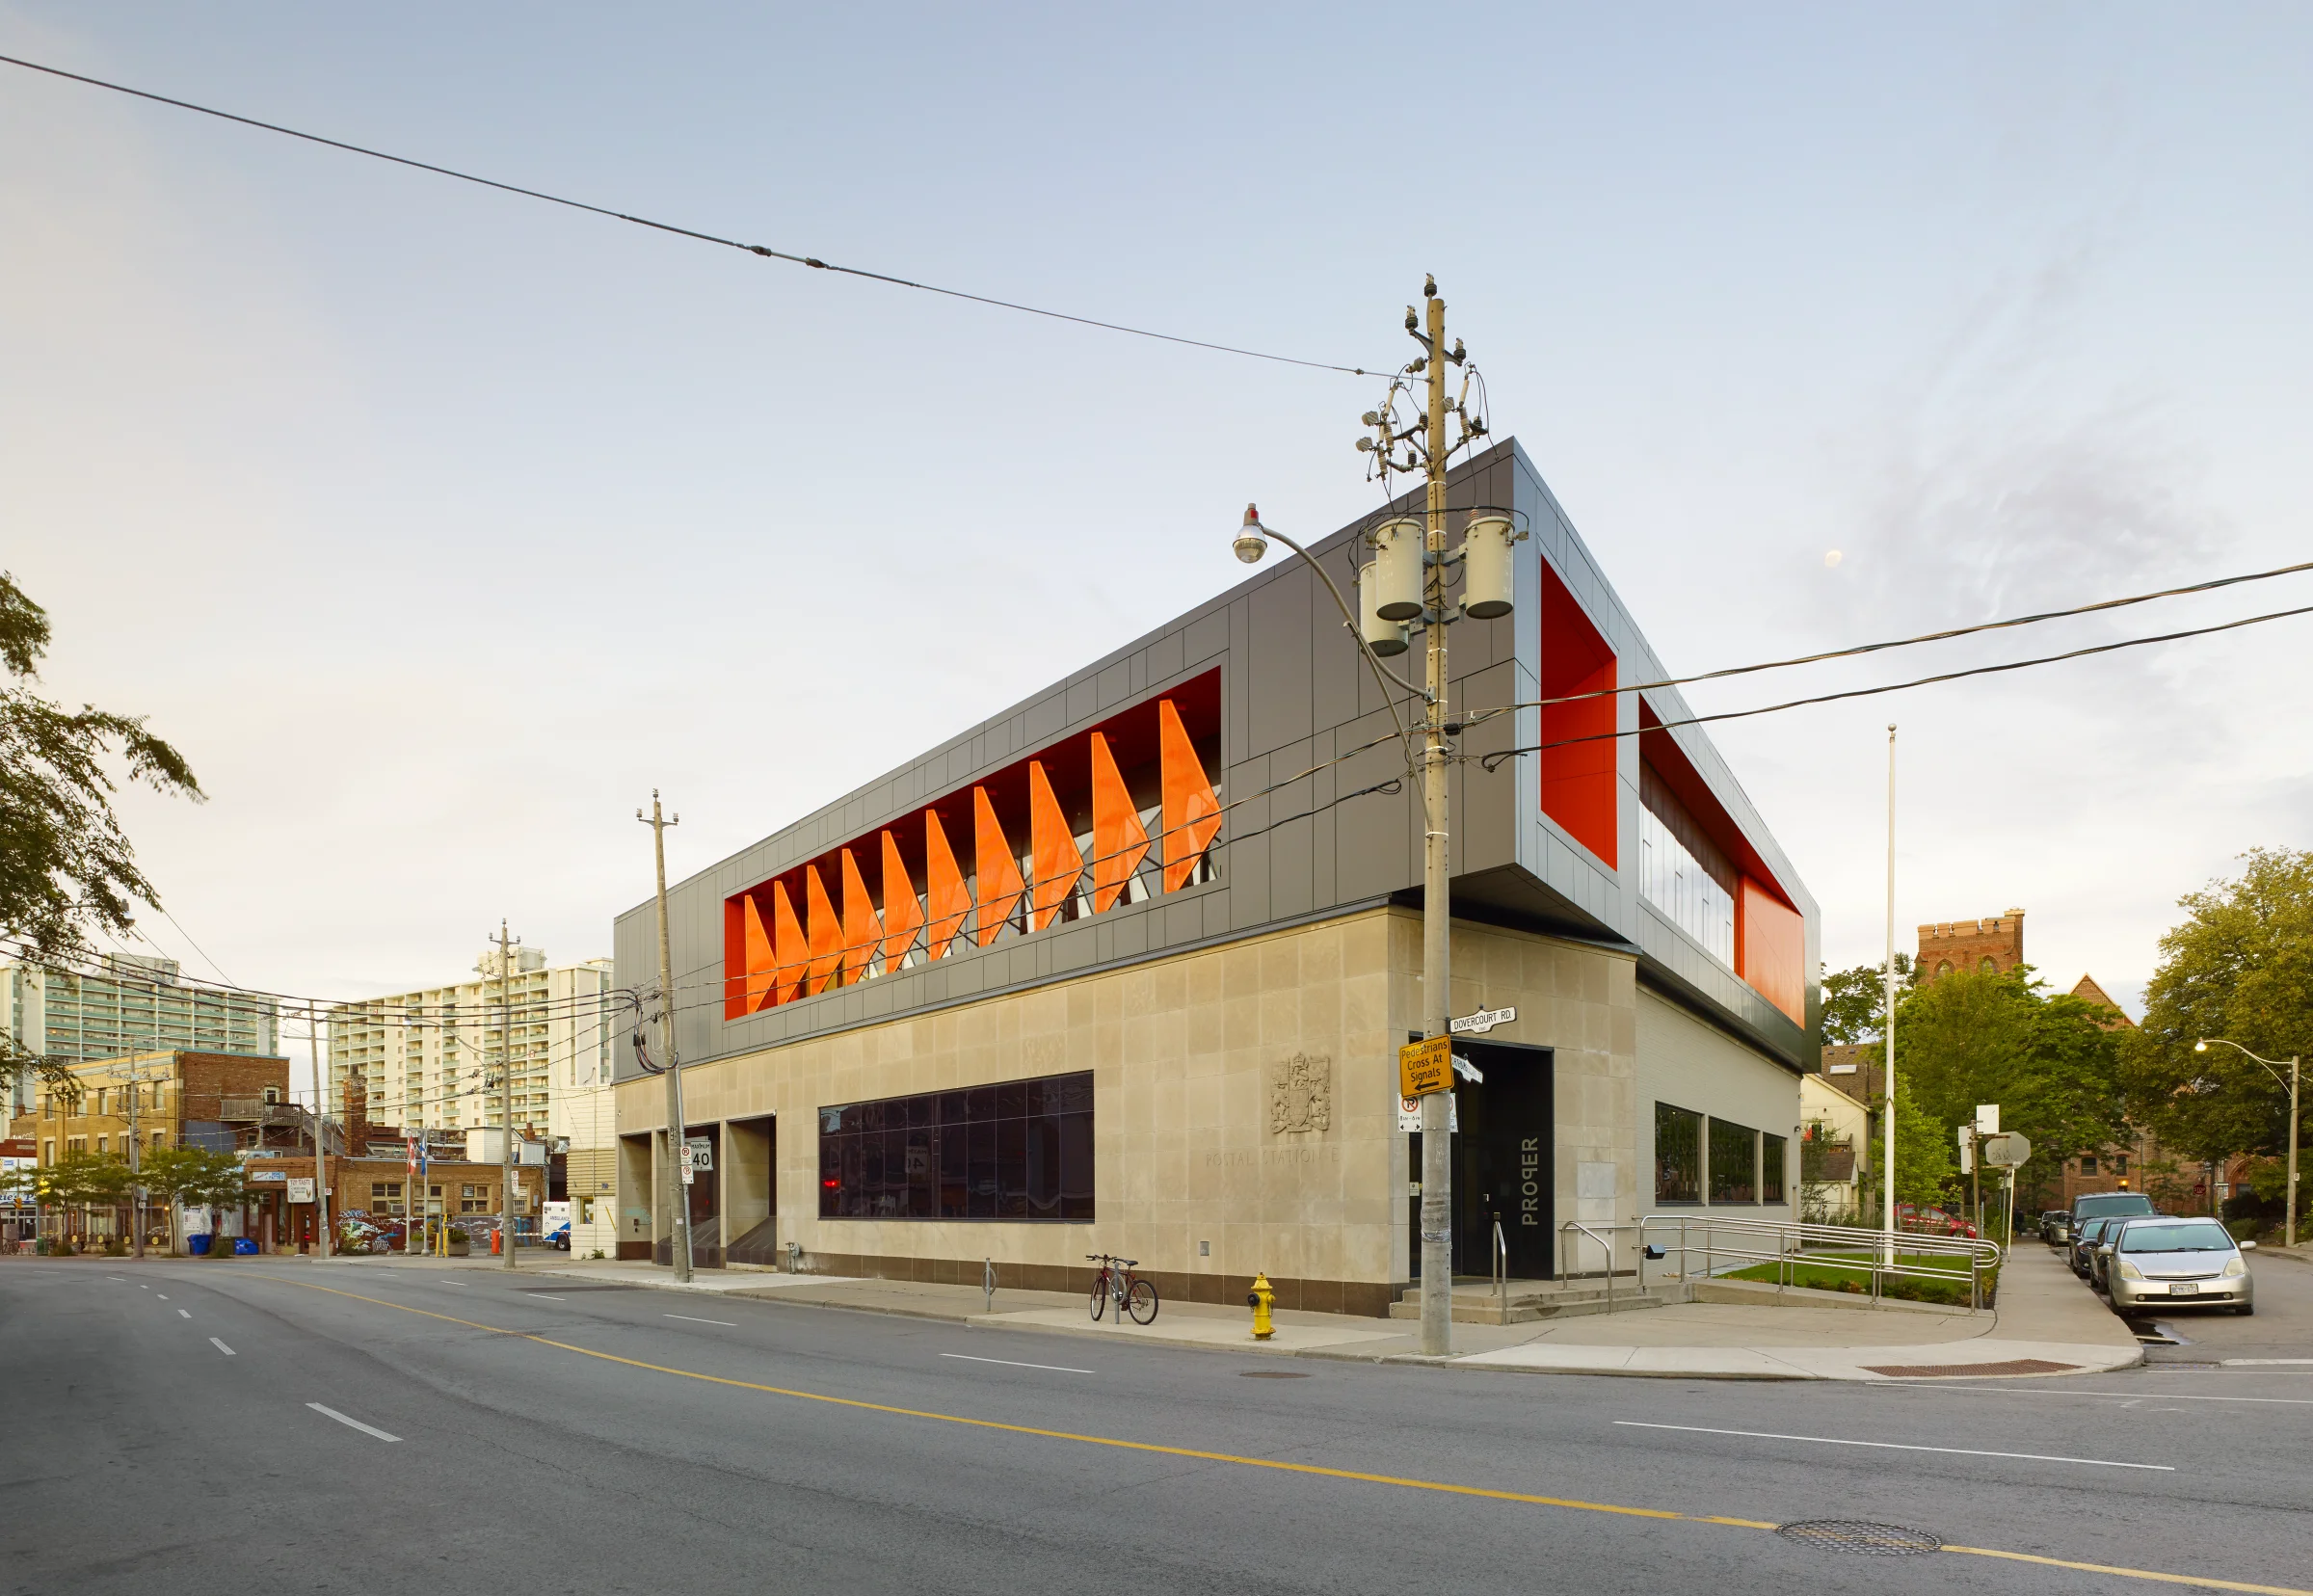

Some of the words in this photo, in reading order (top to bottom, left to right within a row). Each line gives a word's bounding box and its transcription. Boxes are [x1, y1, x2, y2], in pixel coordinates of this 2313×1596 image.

[1453, 1012, 1498, 1030] DOVERCOURT
[1501, 1009, 1512, 1021] RD.
[1401, 1041, 1448, 1060] Pedestrians
[1407, 1058, 1430, 1071] Cross
[1432, 1053, 1443, 1065] At
[1410, 1068, 1441, 1083] Signals
[692, 1153, 709, 1166] 40
[1206, 1152, 1254, 1167] POSTAL
[1262, 1147, 1321, 1165] STATION
[1331, 1147, 1340, 1162] E
